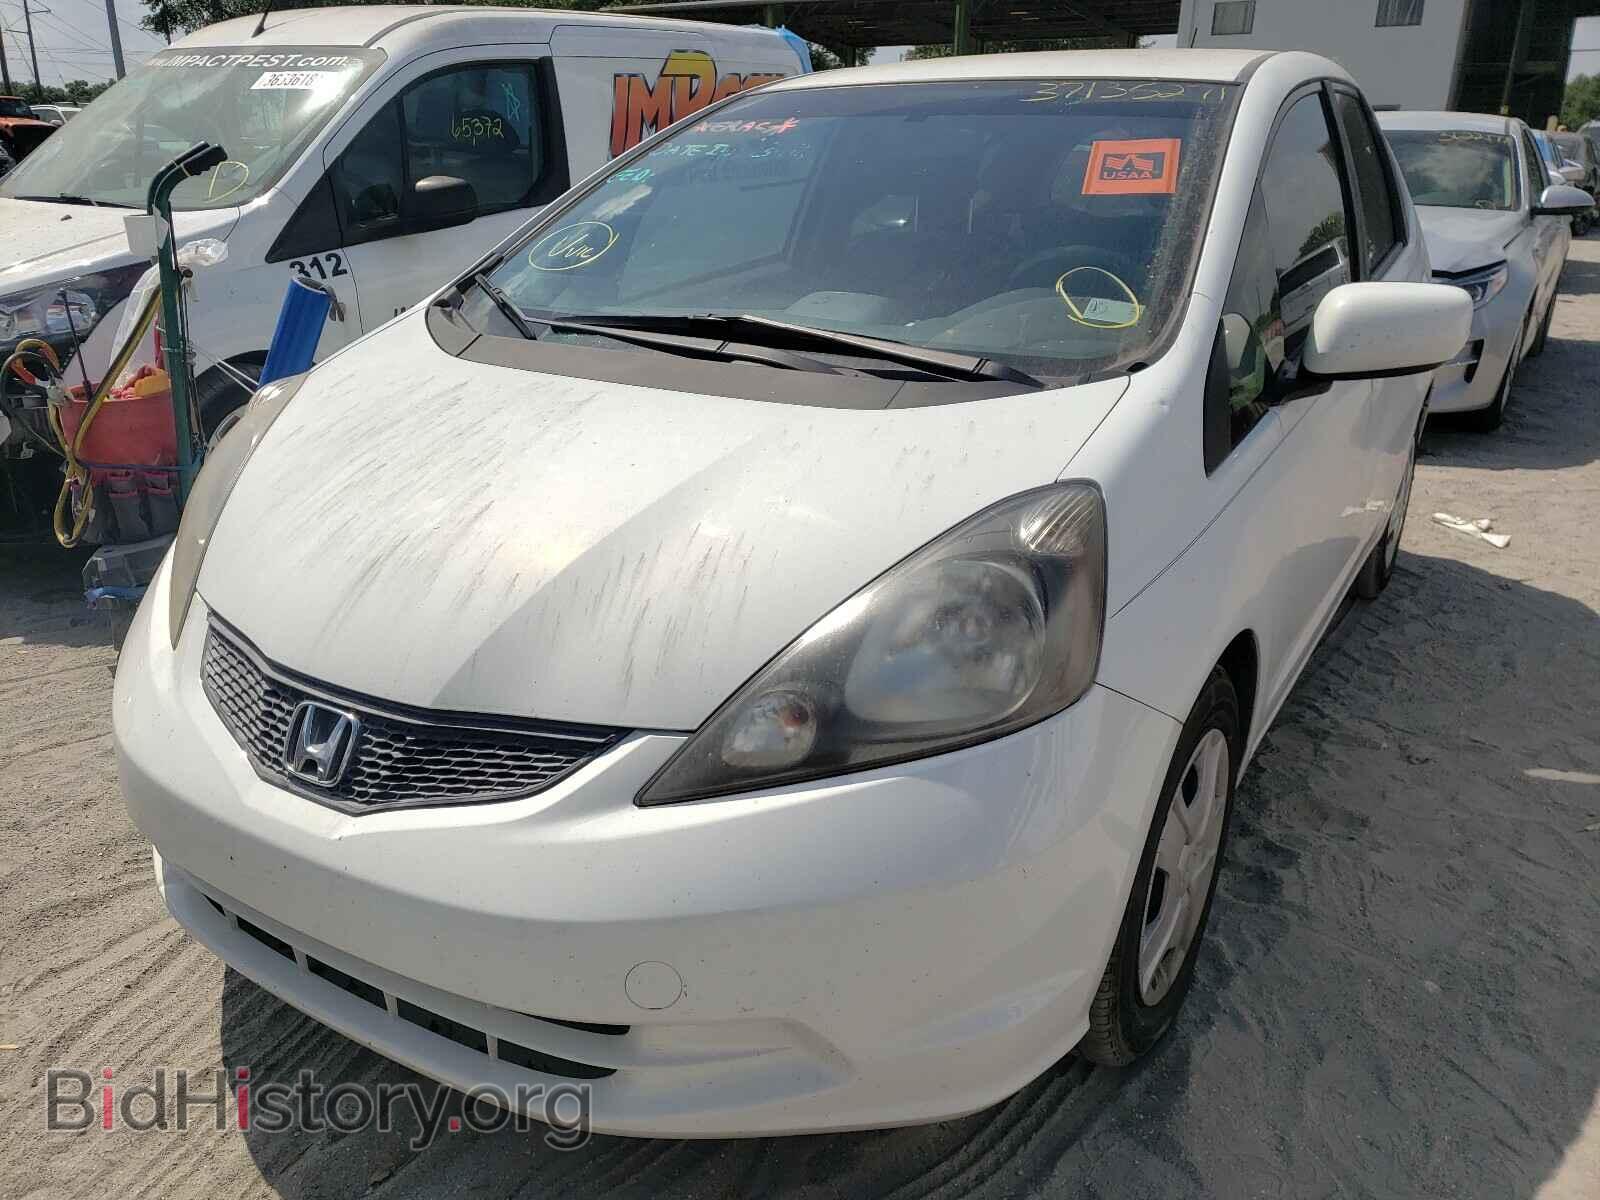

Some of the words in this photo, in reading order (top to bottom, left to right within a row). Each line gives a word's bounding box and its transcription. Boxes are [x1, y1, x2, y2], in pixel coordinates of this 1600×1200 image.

[610, 49, 785, 160] IMP
[1102, 170, 1153, 180] USAA
[289, 252, 348, 280] 312
